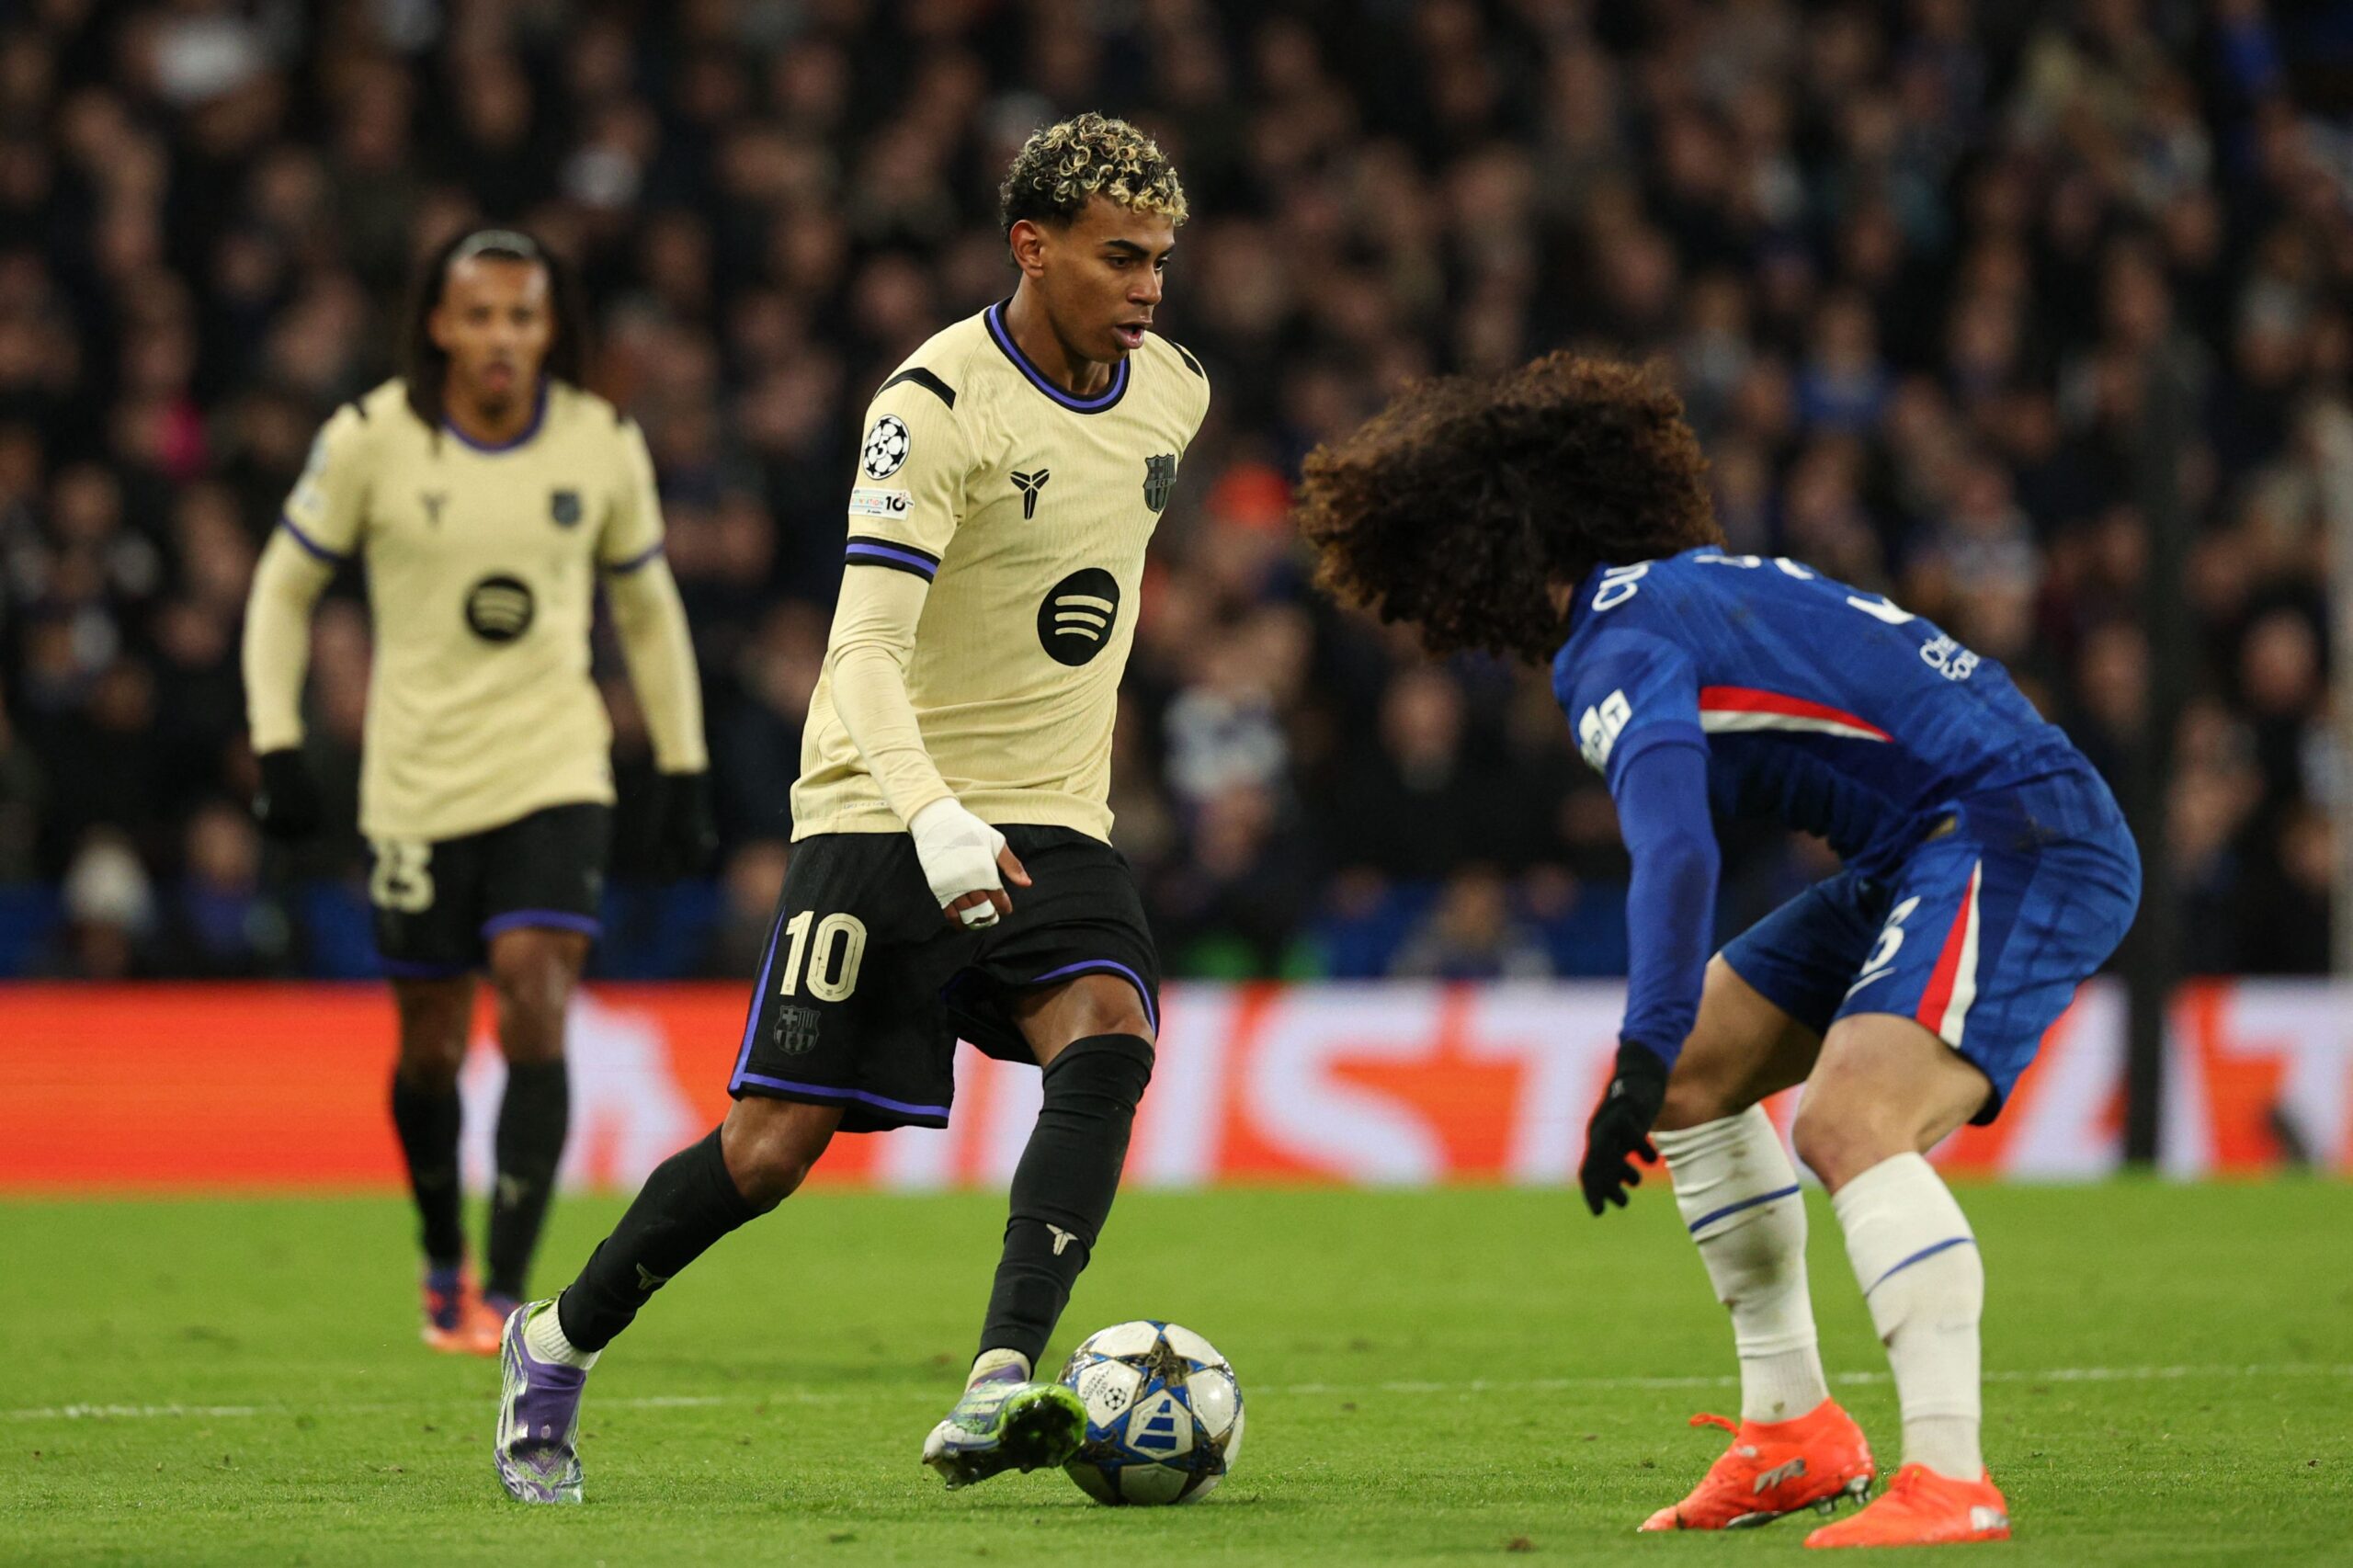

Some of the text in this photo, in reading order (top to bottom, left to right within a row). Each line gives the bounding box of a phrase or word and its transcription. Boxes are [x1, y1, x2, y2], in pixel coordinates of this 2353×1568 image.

[886, 496, 906, 512] 10
[779, 910, 868, 1002] 10
[1859, 895, 1921, 977] 3
